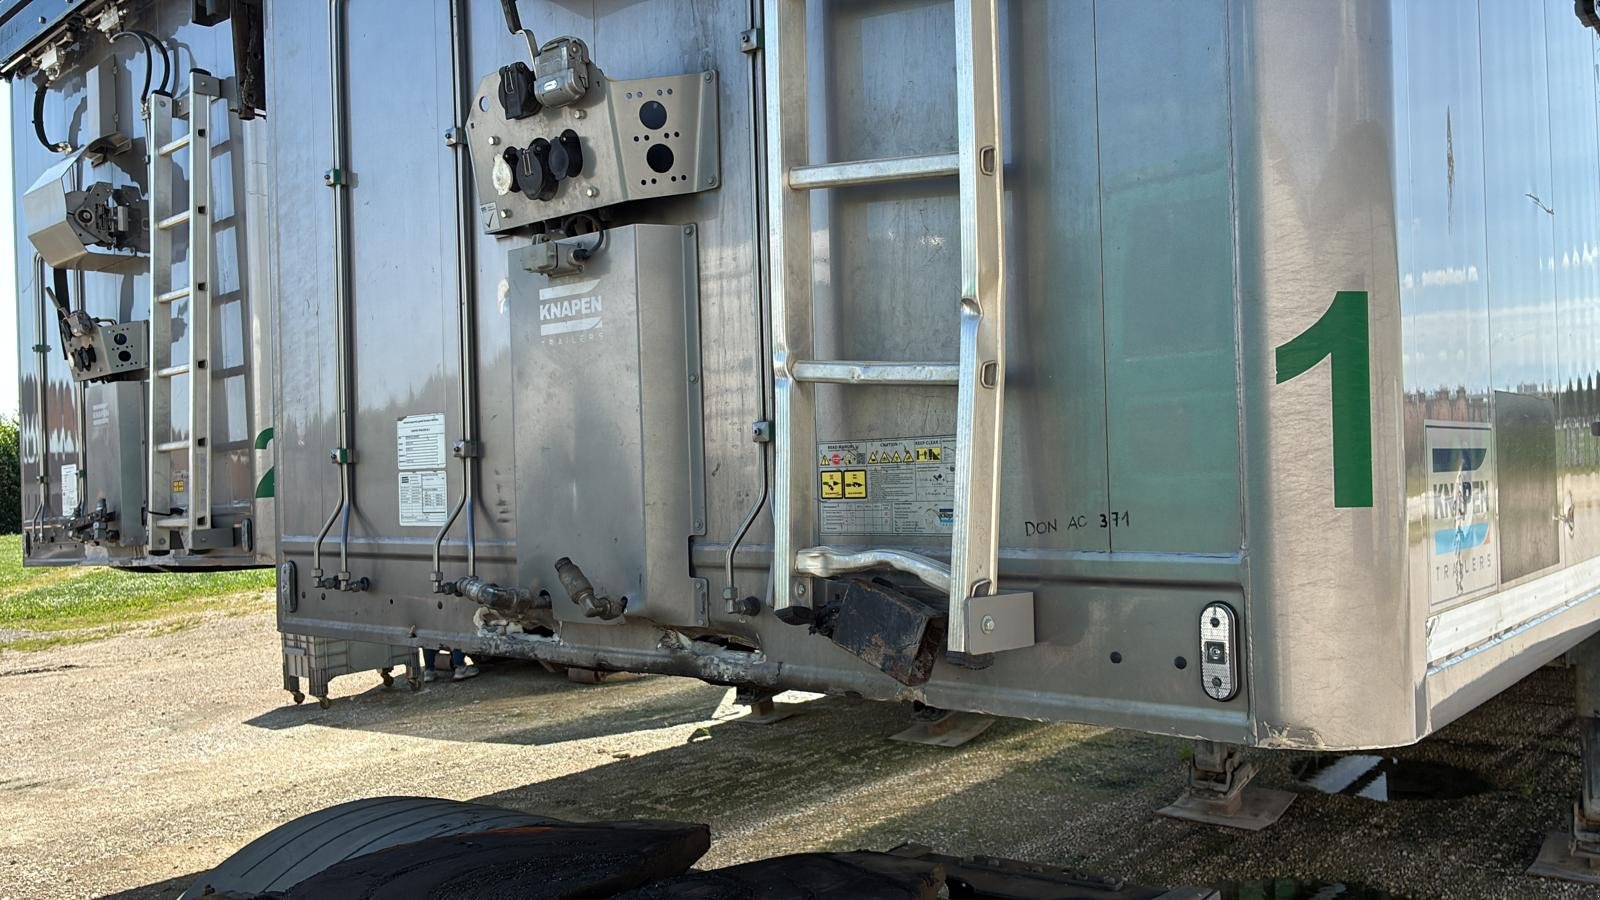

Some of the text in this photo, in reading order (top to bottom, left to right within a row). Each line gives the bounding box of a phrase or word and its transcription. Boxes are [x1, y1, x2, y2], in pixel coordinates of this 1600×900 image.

[540, 295, 602, 320] KNAPEN
[1274, 290, 1374, 508] 1
[1024, 518, 1058, 537] DON
[1067, 515, 1088, 530] AC
